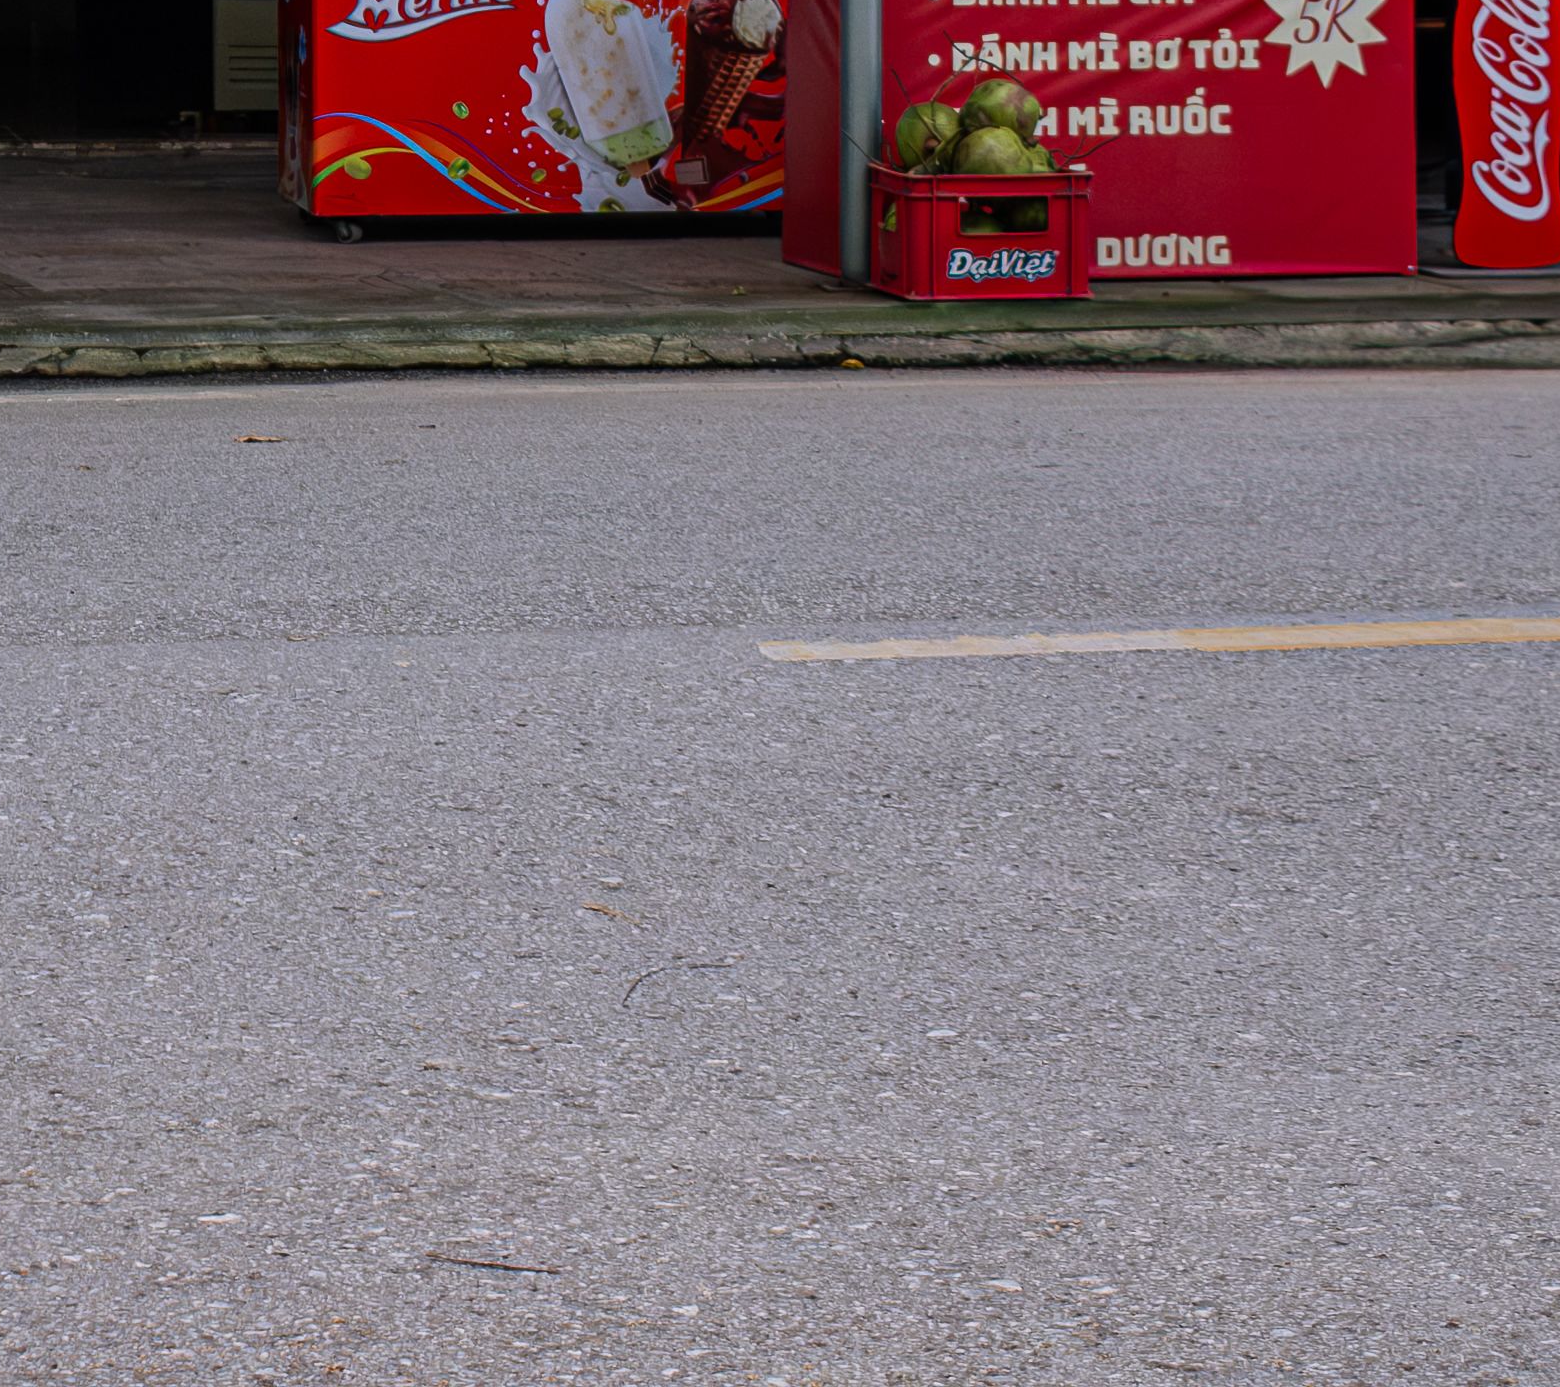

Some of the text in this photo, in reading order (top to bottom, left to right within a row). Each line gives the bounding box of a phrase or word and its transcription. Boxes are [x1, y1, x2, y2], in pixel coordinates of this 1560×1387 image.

[952, 28, 1261, 72] BÁNH MÌ BƠ TỎI
[1068, 97, 1120, 136] MÌ
[1129, 87, 1231, 135] RUỐC
[1097, 233, 1230, 267] DƯƠNG
